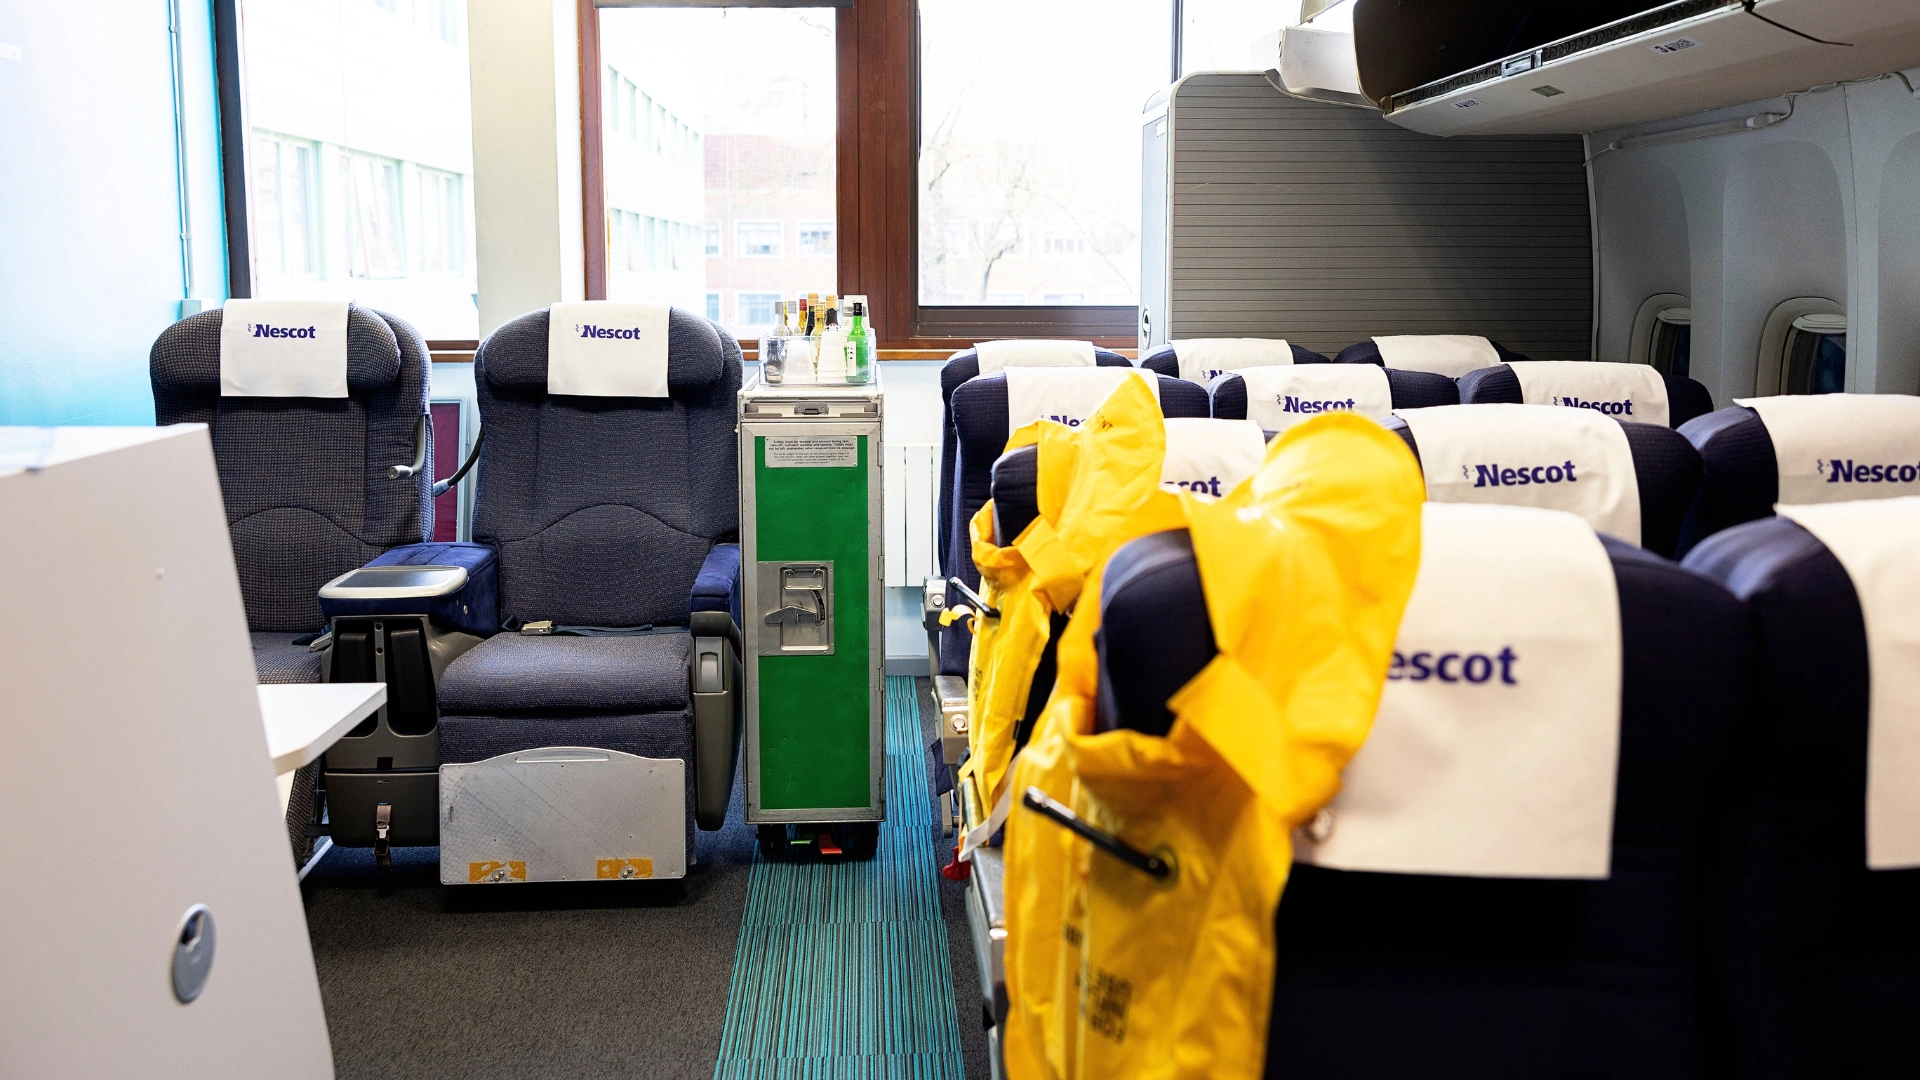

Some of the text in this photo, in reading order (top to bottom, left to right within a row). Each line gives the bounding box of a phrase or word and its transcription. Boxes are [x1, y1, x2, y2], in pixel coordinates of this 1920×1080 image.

[253, 324, 316, 339] Nescot
[581, 324, 641, 340] Nescot
[1282, 395, 1356, 414] Nescot
[1474, 460, 1577, 488] Nescot
[1387, 644, 1518, 686] escot
